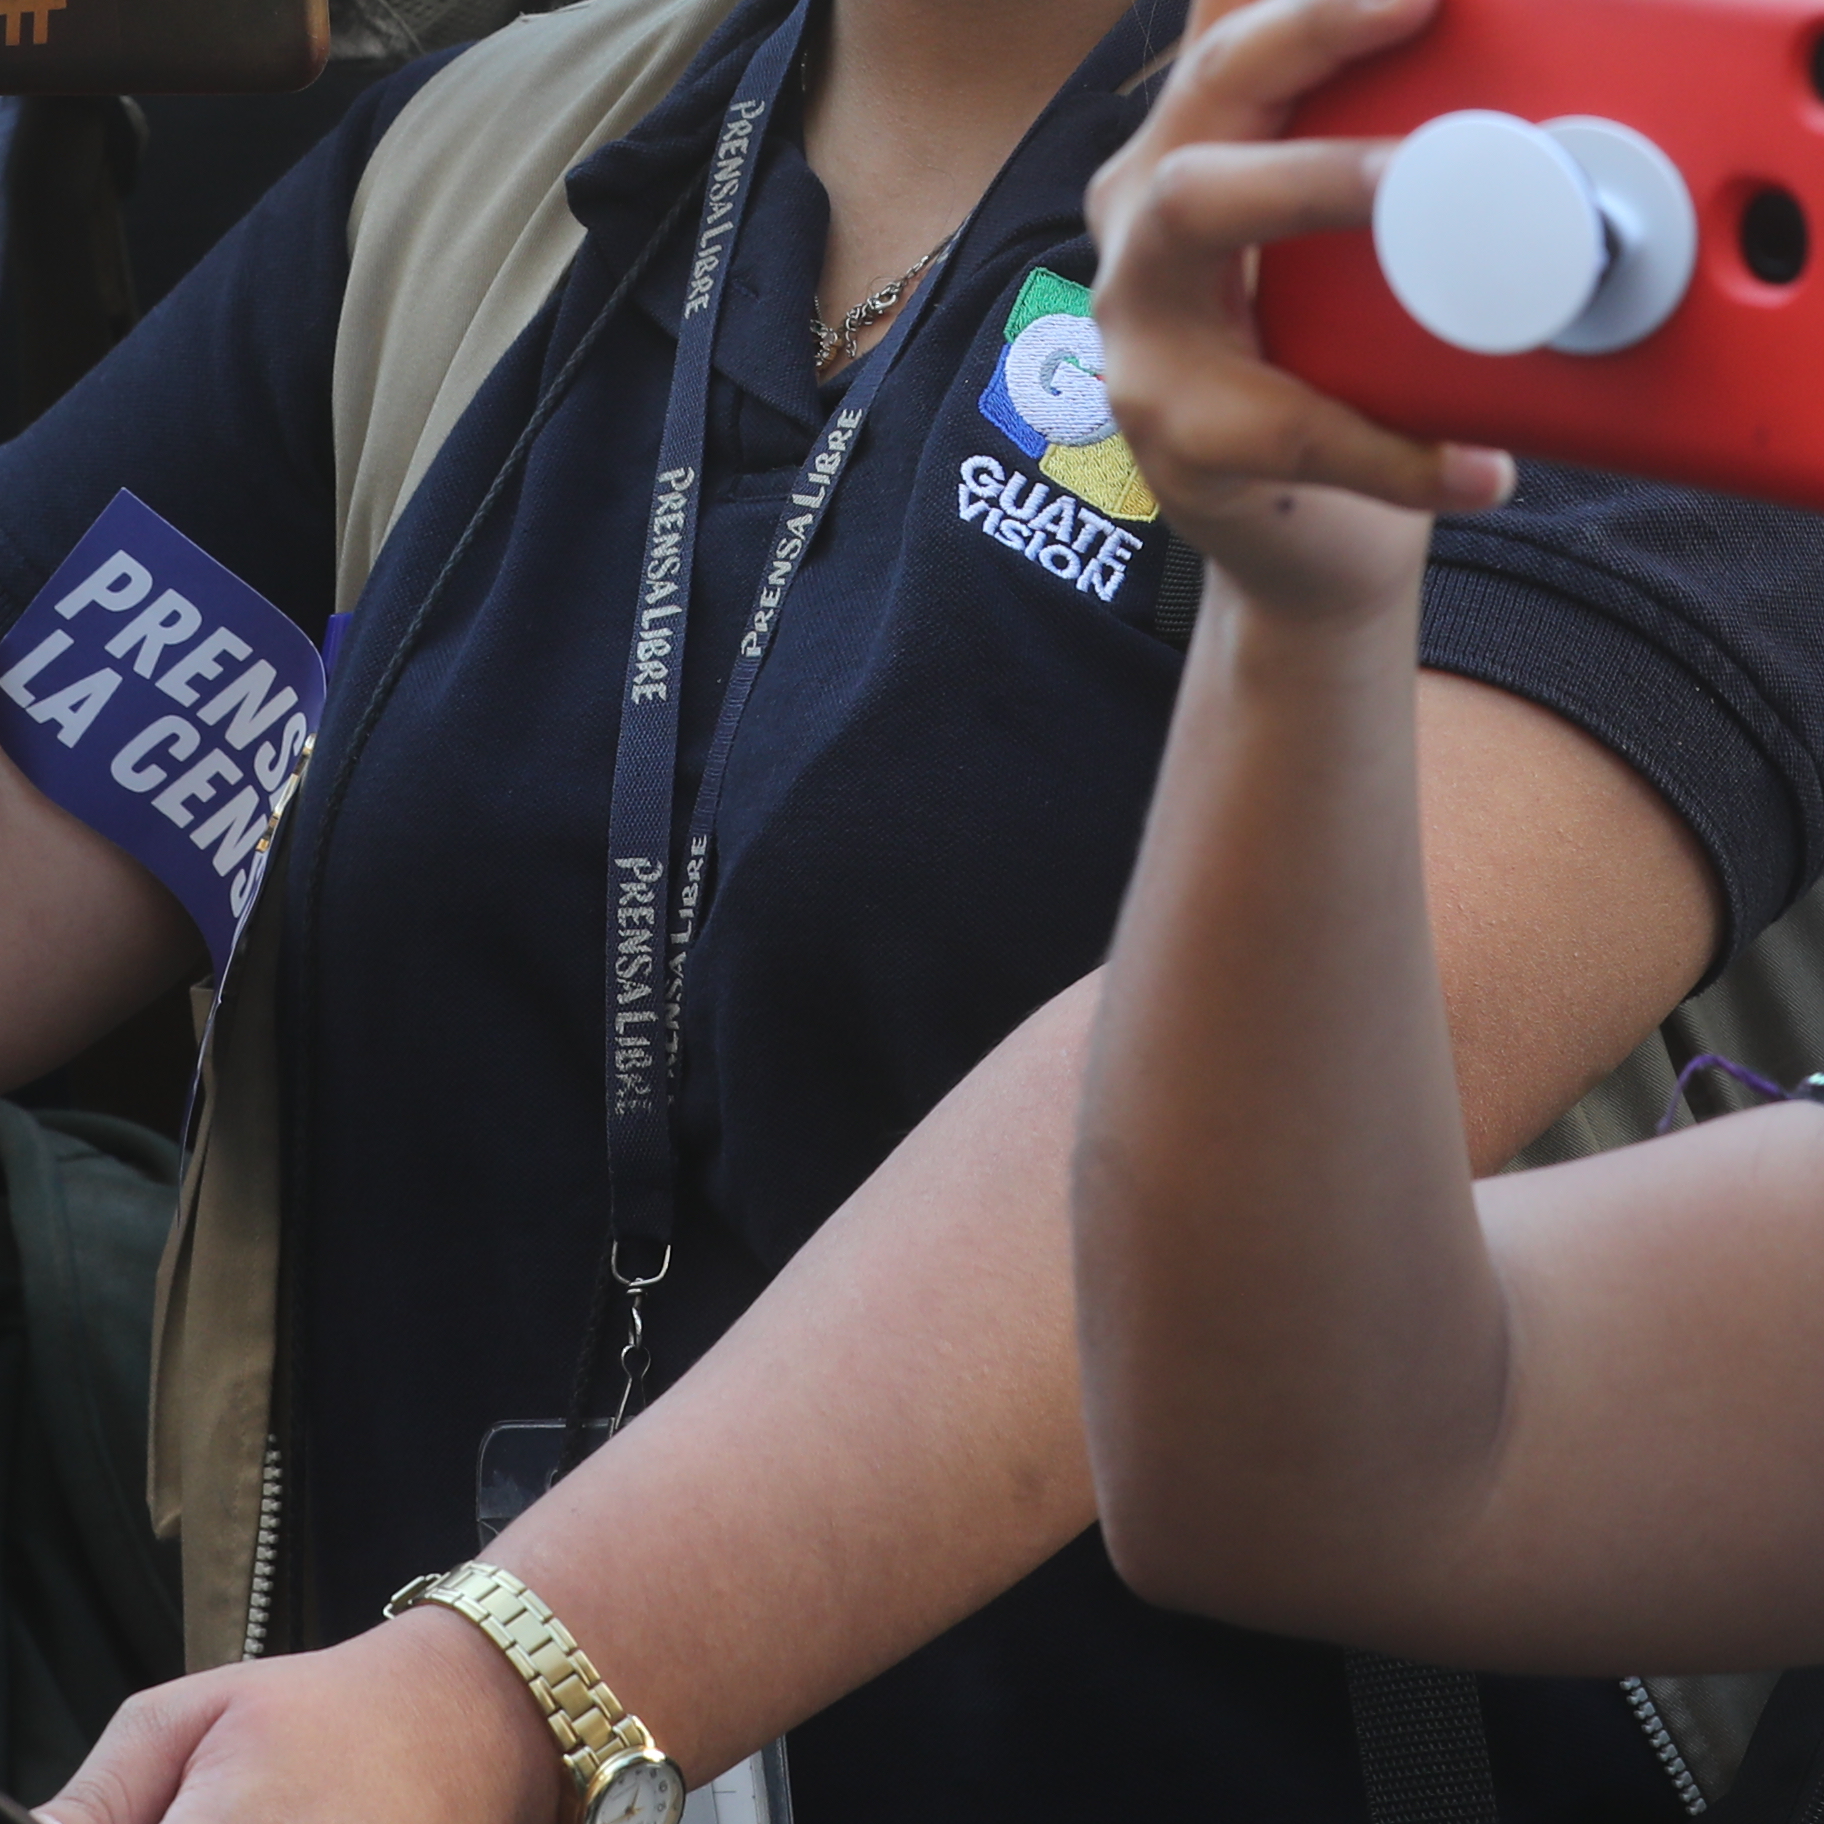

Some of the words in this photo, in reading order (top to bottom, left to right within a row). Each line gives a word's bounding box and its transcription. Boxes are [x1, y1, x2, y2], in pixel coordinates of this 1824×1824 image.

[702, 99, 764, 222] PRENSA
[685, 212, 733, 319] LIBRE
[645, 466, 695, 604] PRENSA
[741, 512, 813, 658] PRENSA
[793, 407, 863, 509] LIBRE
[958, 483, 1126, 603] VISION
[960, 455, 1144, 573] GUATE
[54, 549, 308, 802] PRENS
[632, 601, 682, 704] LIBRE
[614, 857, 664, 1005] PRENSA
[670, 834, 707, 945] LIBRE
